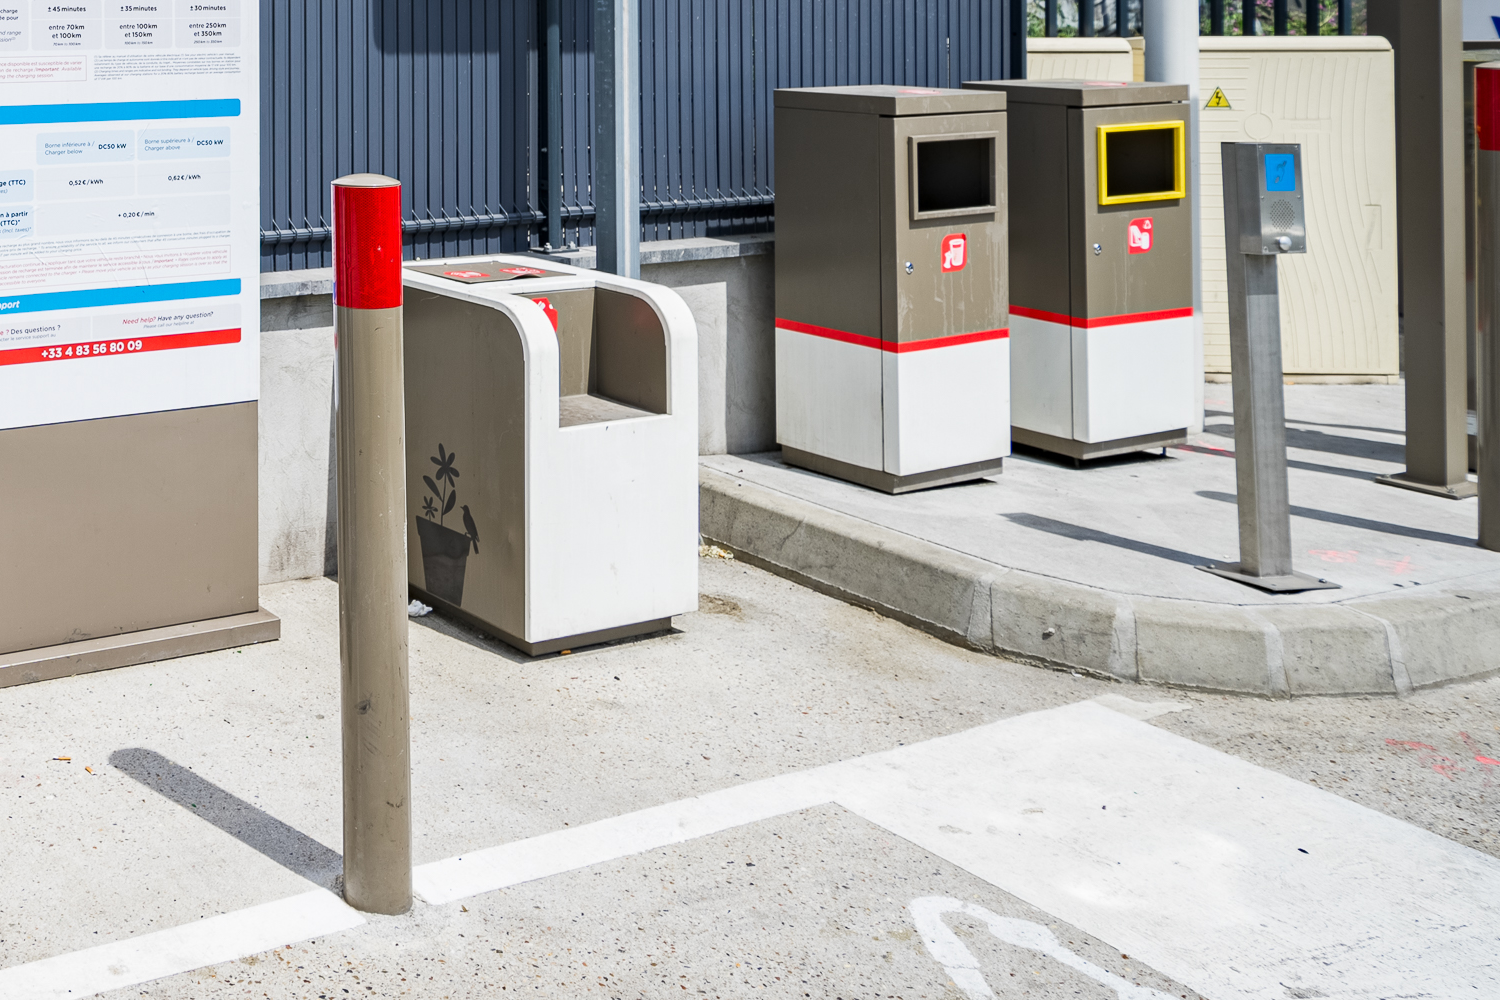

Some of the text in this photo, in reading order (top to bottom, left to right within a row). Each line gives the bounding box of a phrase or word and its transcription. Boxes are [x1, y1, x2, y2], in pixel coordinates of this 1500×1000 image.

[186, 311, 213, 319] question?
[25, 326, 55, 334] questions
[42, 340, 142, 358] +33 4 83 56 80 09
